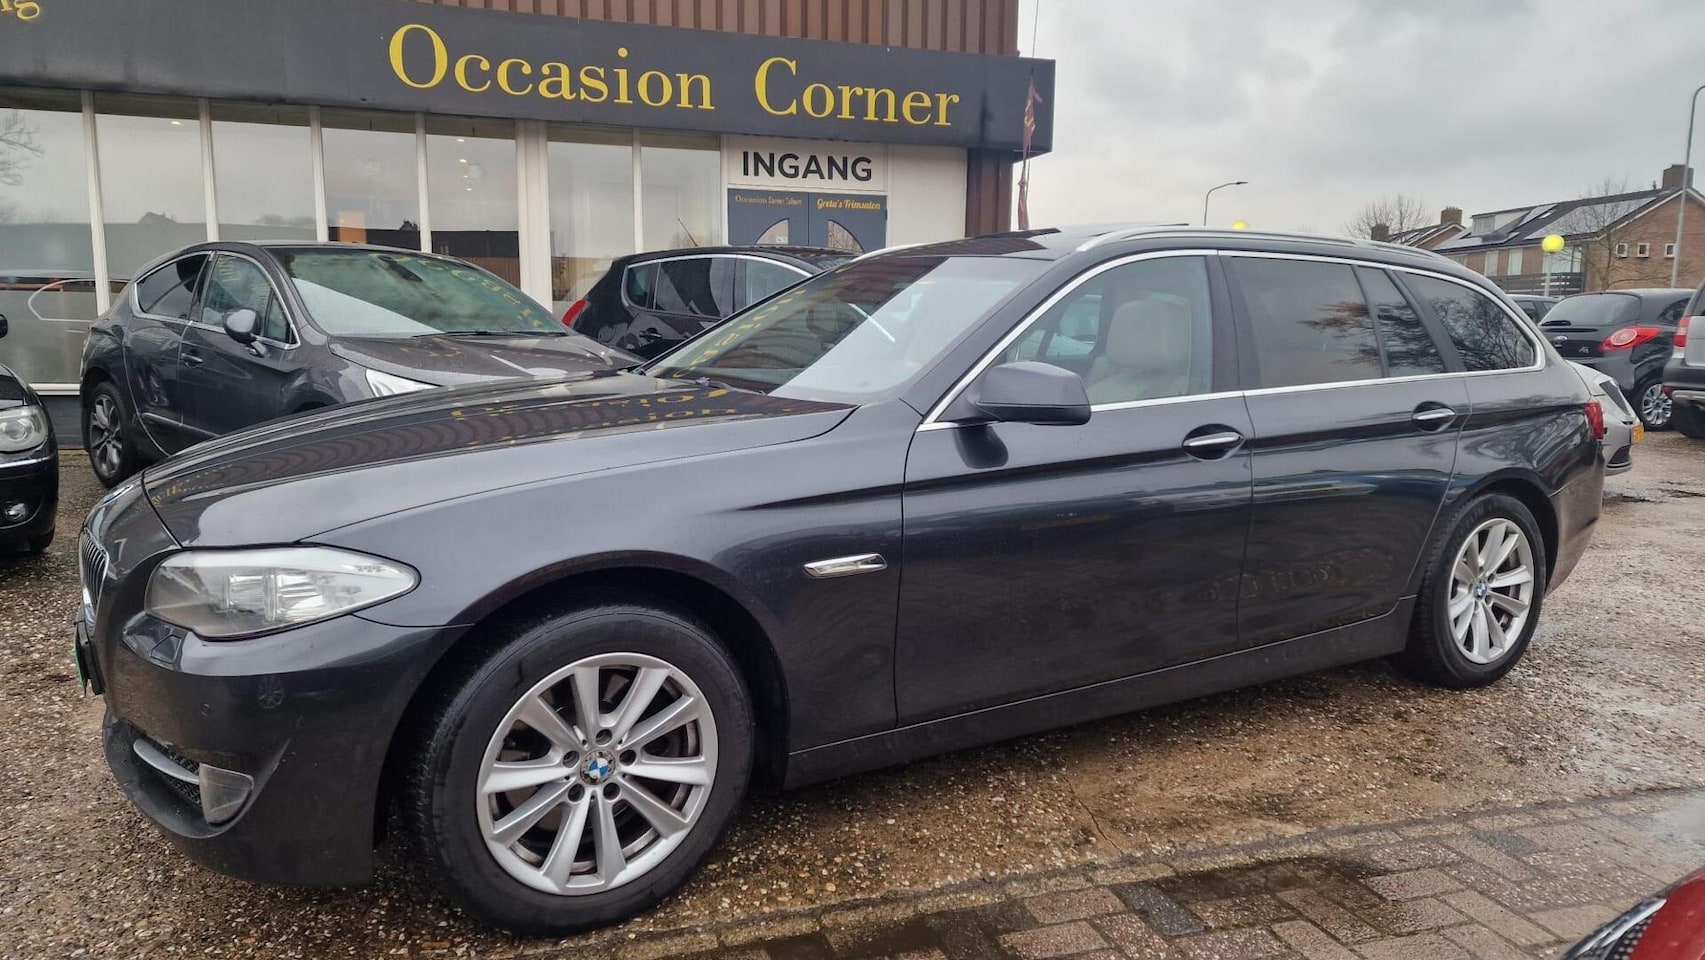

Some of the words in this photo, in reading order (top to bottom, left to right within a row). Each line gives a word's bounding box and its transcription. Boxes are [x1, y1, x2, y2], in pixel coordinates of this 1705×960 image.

[388, 23, 715, 111] Occasion
[754, 56, 961, 127] Corner
[743, 151, 873, 181] INGANG
[817, 198, 843, 209] Greta's
